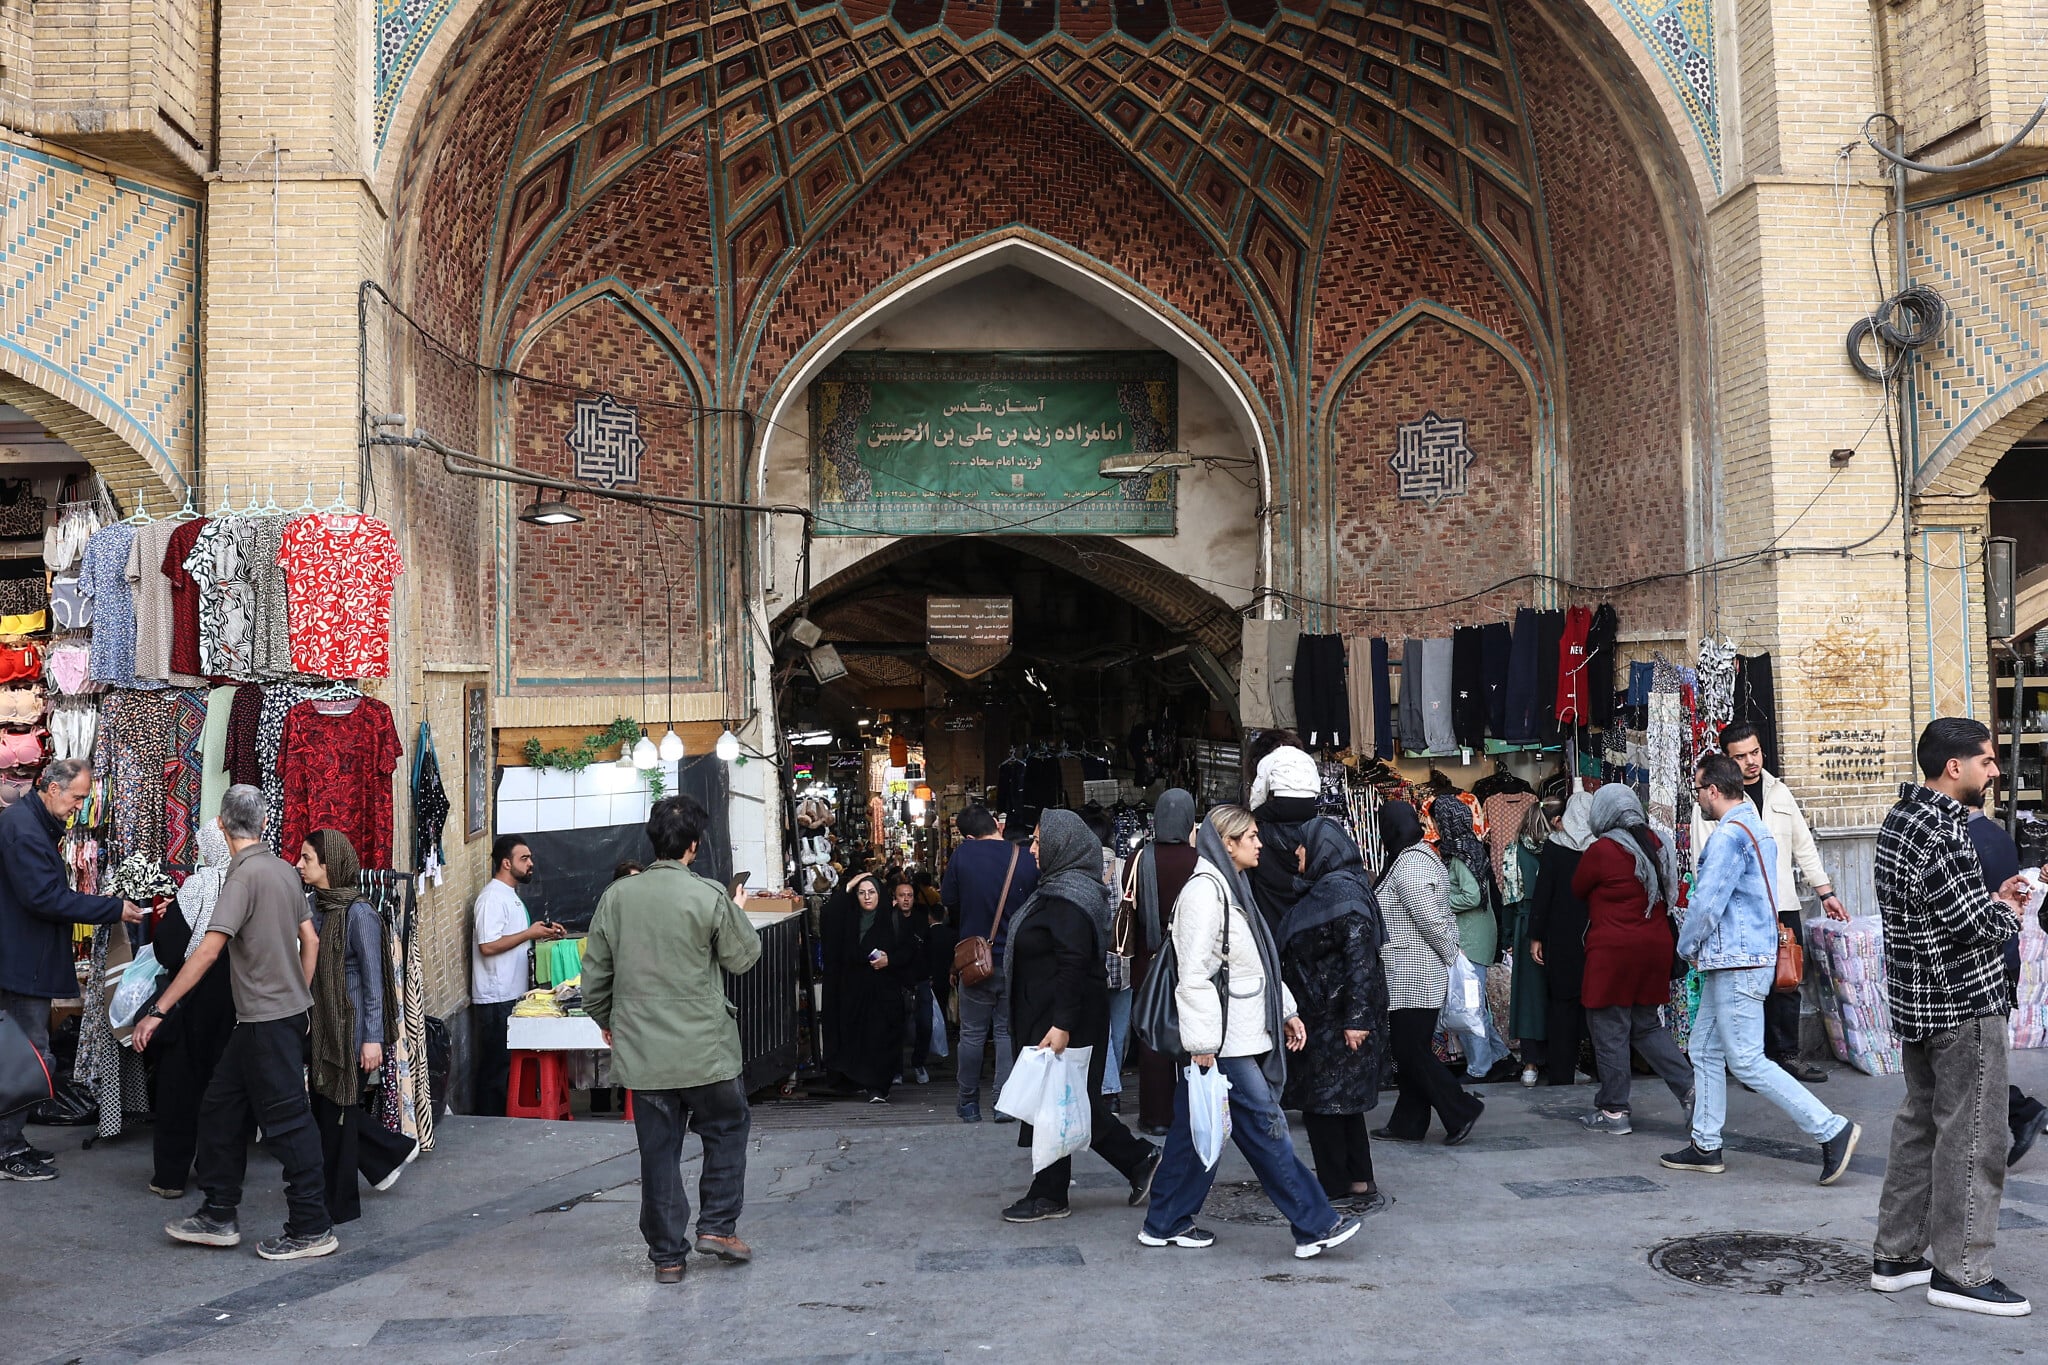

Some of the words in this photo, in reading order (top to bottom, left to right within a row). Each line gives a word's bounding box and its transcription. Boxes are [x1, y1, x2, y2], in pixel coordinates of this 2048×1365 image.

[943, 399, 992, 416] مقدس
[994, 396, 1046, 416] آستان
[868, 422, 929, 447] الحسین
[934, 428, 954, 447] بن
[959, 422, 992, 446] علی
[997, 428, 1017, 446] بن
[1023, 426, 1051, 447] زید
[1055, 421, 1122, 447] امامزاده
[970, 456, 994, 468] سجاد
[996, 456, 1014, 468] امام
[1016, 454, 1041, 469] فرزند
